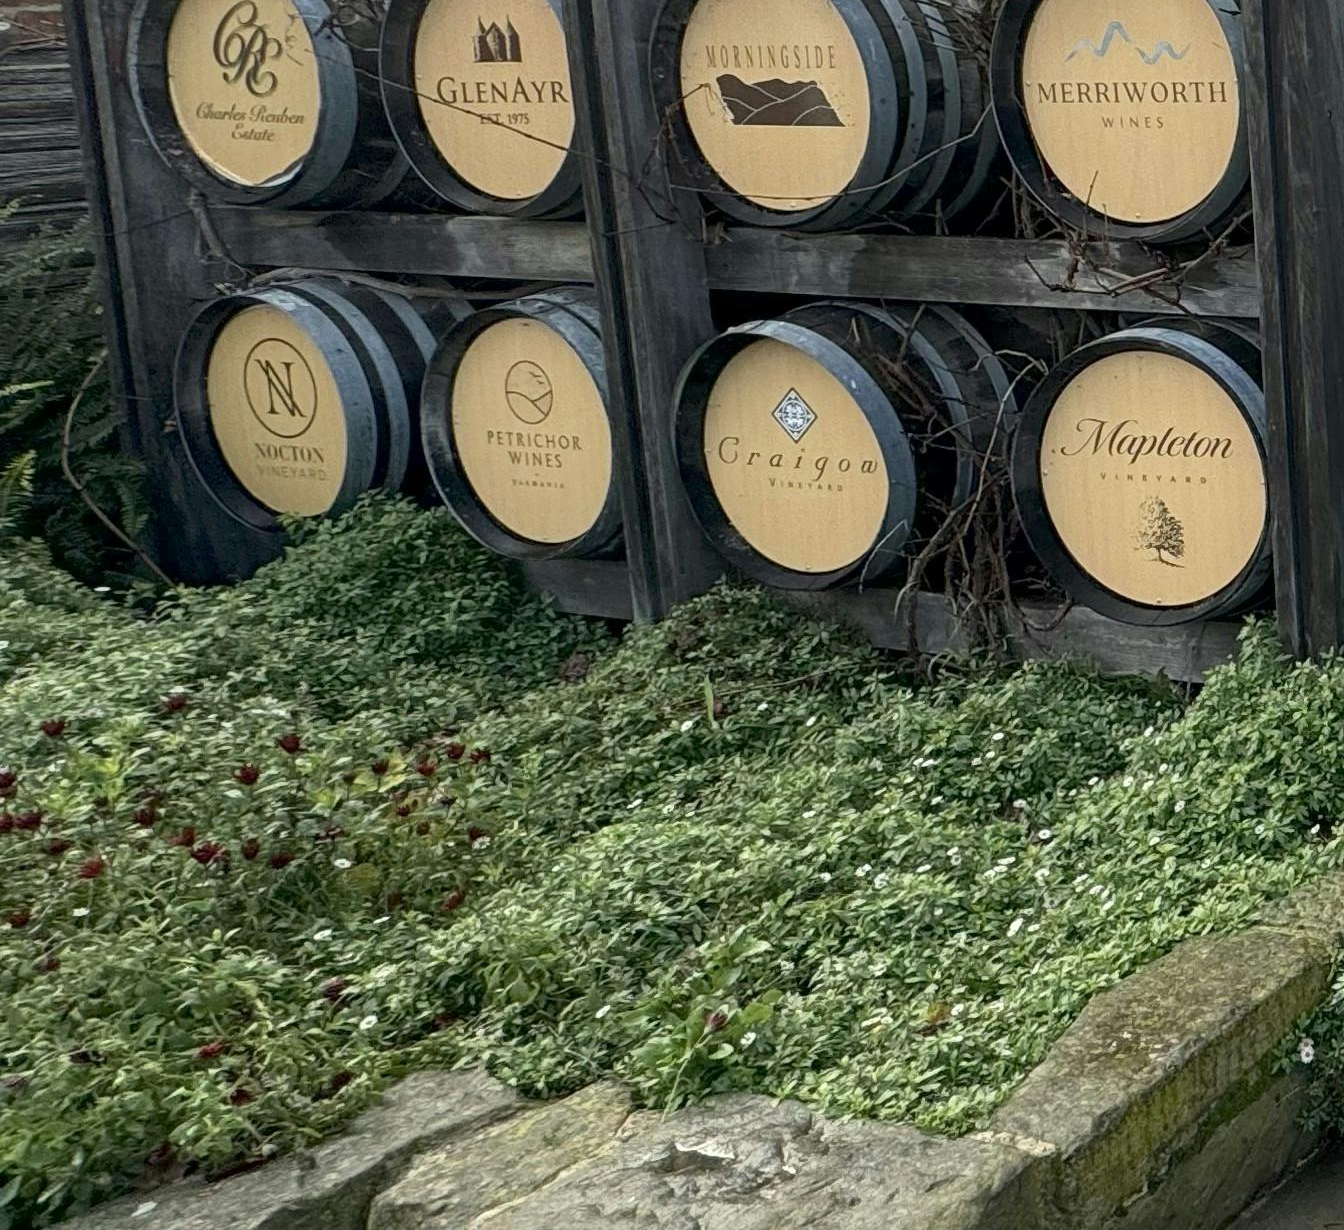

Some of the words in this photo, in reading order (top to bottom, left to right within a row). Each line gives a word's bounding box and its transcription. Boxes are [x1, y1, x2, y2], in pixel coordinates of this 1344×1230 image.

[705, 45, 837, 69] MORNINGSIDE
[1037, 81, 1228, 104] MERRIWORTH
[196, 102, 246, 121] Charles
[250, 104, 305, 124] Reuben
[507, 113, 530, 124] 1975
[1101, 117, 1164, 129] WINES
[231, 123, 275, 142] Estate
[253, 359, 308, 418] N
[487, 430, 583, 451] PETRICHOR
[1060, 418, 1233, 466] Mapleton
[254, 442, 325, 464] NOCTON
[508, 451, 563, 468] WINES
[718, 436, 878, 482] Craigow
[256, 464, 327, 481] VINEYARD
[1100, 472, 1208, 484] VINEYARD
